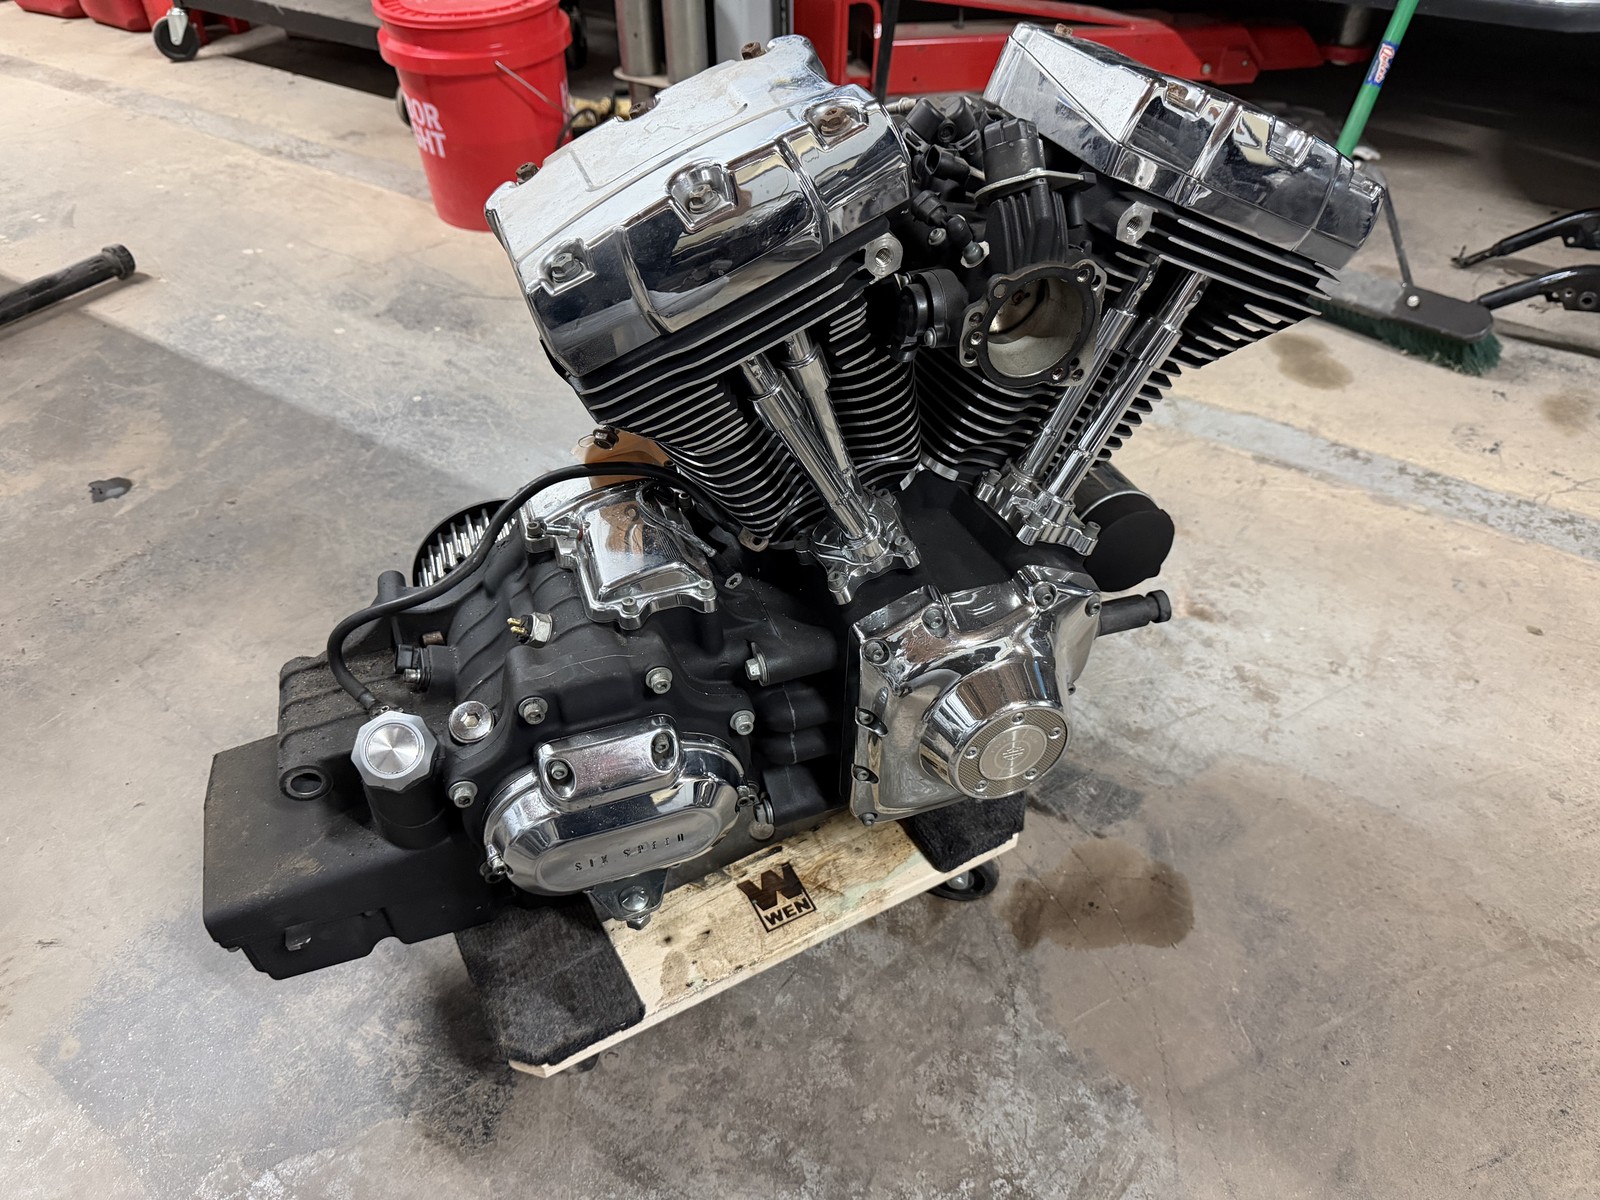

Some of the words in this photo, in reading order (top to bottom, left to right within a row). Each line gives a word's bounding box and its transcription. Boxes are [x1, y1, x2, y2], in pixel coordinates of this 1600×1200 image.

[403, 91, 444, 131] OR
[574, 854, 609, 871] SIX
[764, 898, 811, 926] WEN
